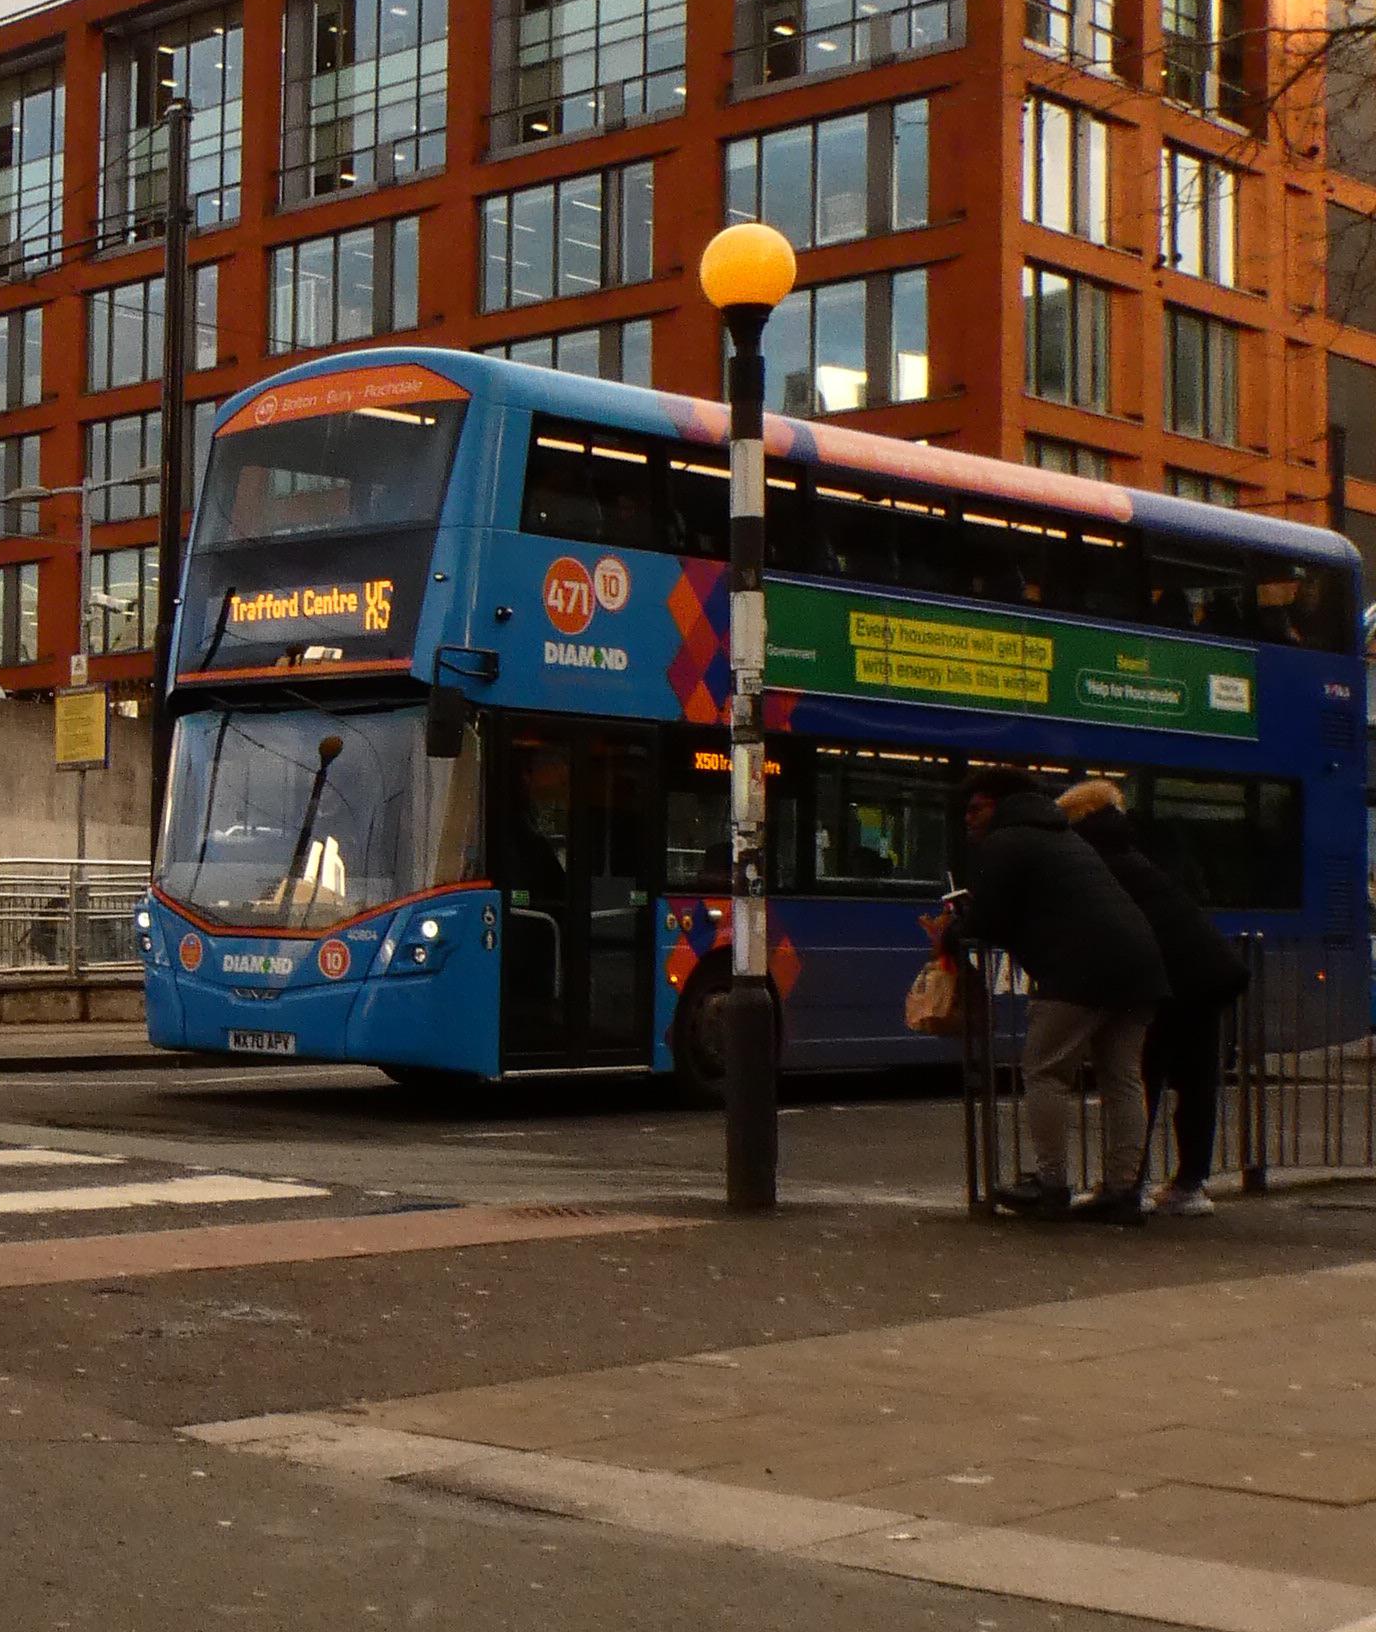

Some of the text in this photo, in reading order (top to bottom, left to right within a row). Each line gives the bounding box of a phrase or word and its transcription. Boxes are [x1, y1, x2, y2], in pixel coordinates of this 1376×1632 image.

[546, 578, 590, 616] 471
[602, 572, 621, 599] 10
[231, 585, 358, 622] Trafford Centre
[855, 617, 895, 641] Every
[900, 625, 968, 649] household
[896, 664, 942, 686] energy
[695, 752, 719, 770] X50
[326, 953, 342, 970] 10
